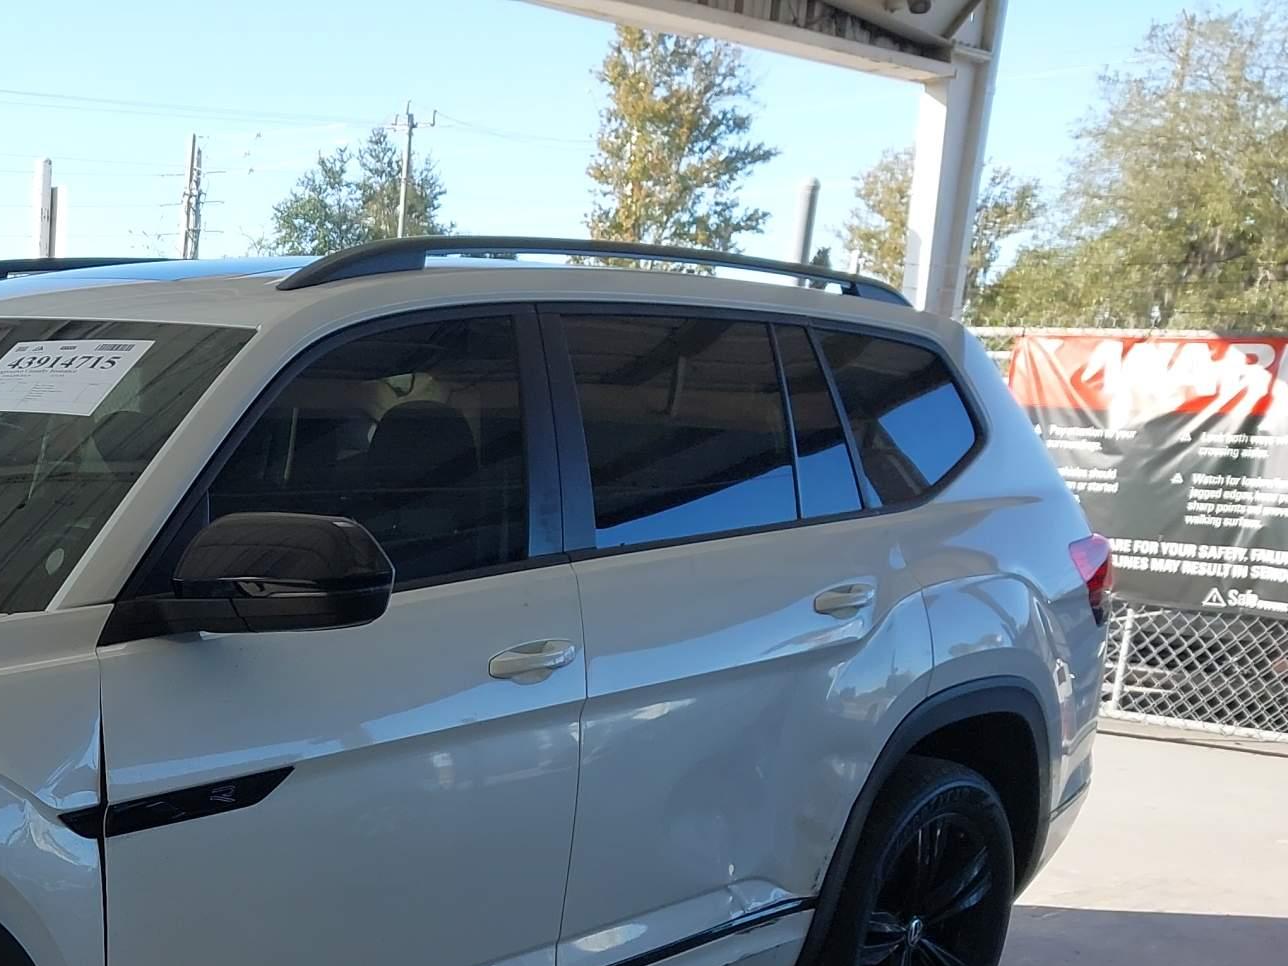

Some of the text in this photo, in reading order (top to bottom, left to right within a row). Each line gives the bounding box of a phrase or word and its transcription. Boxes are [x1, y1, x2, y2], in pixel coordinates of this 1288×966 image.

[7, 355, 121, 369] 43914715
[1225, 433, 1249, 445] both
[1198, 446, 1240, 459] crossing
[1088, 468, 1118, 480] should
[1192, 473, 1225, 486] Watch
[1226, 475, 1241, 486] for
[1087, 482, 1119, 493] started
[1189, 487, 1222, 501] jagged
[1187, 501, 1216, 514] sharp
[1216, 503, 1247, 515] points
[1185, 515, 1223, 528] walking
[1133, 540, 1159, 554] FOR
[1160, 542, 1197, 558] YOUR
[1199, 545, 1248, 562] SAFETY.
[1150, 558, 1182, 573] MAY
[1181, 560, 1233, 578] RESULT
[1232, 564, 1249, 579] IN
